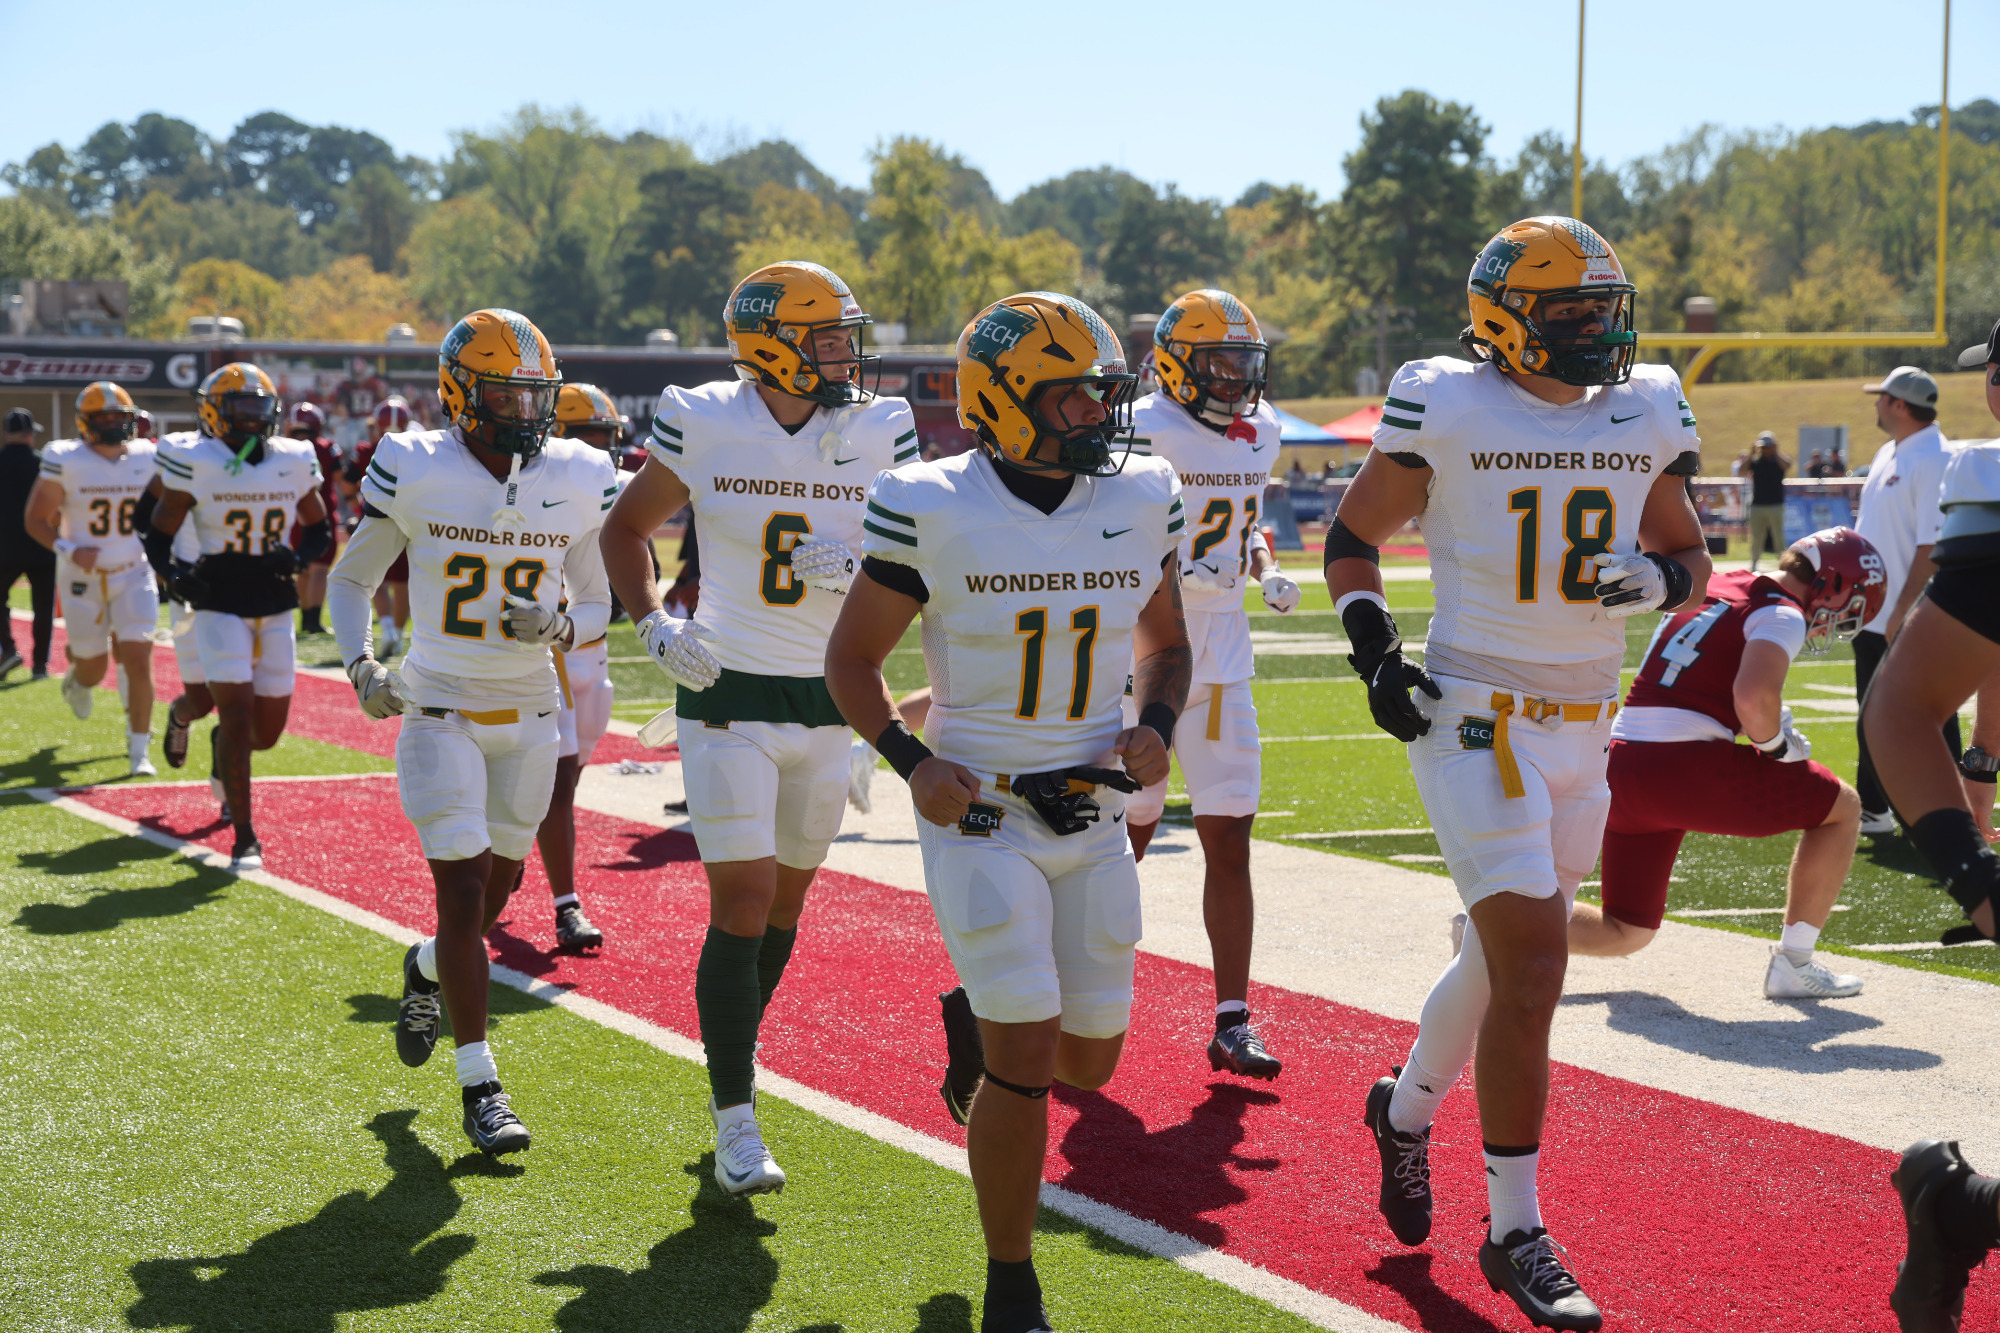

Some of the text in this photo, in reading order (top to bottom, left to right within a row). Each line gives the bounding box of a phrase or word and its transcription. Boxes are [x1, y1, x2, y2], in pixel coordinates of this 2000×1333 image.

[734, 297, 776, 314] TECH
[975, 318, 1021, 351] TECH
[165, 354, 199, 389] G
[516, 368, 544, 377] Riddell
[1470, 451, 1652, 474] WONDER BOYS
[79, 485, 123, 495] WONDER
[713, 476, 865, 503] WONDER BOYS
[1179, 471, 1267, 487] WONDER BOYS
[212, 490, 296, 502] WONDER BOYS
[224, 506, 286, 556] 38
[427, 522, 570, 548] WONDER BOYS
[1190, 494, 1258, 577] 21
[1507, 486, 1616, 604] 18
[758, 510, 813, 607] 8
[1858, 554, 1883, 586] 84
[441, 551, 548, 641] 28
[965, 569, 1141, 594] WONDER BOYS
[1634, 597, 1732, 688] 4
[1014, 604, 1100, 721] 11
[961, 811, 998, 828] TECH
